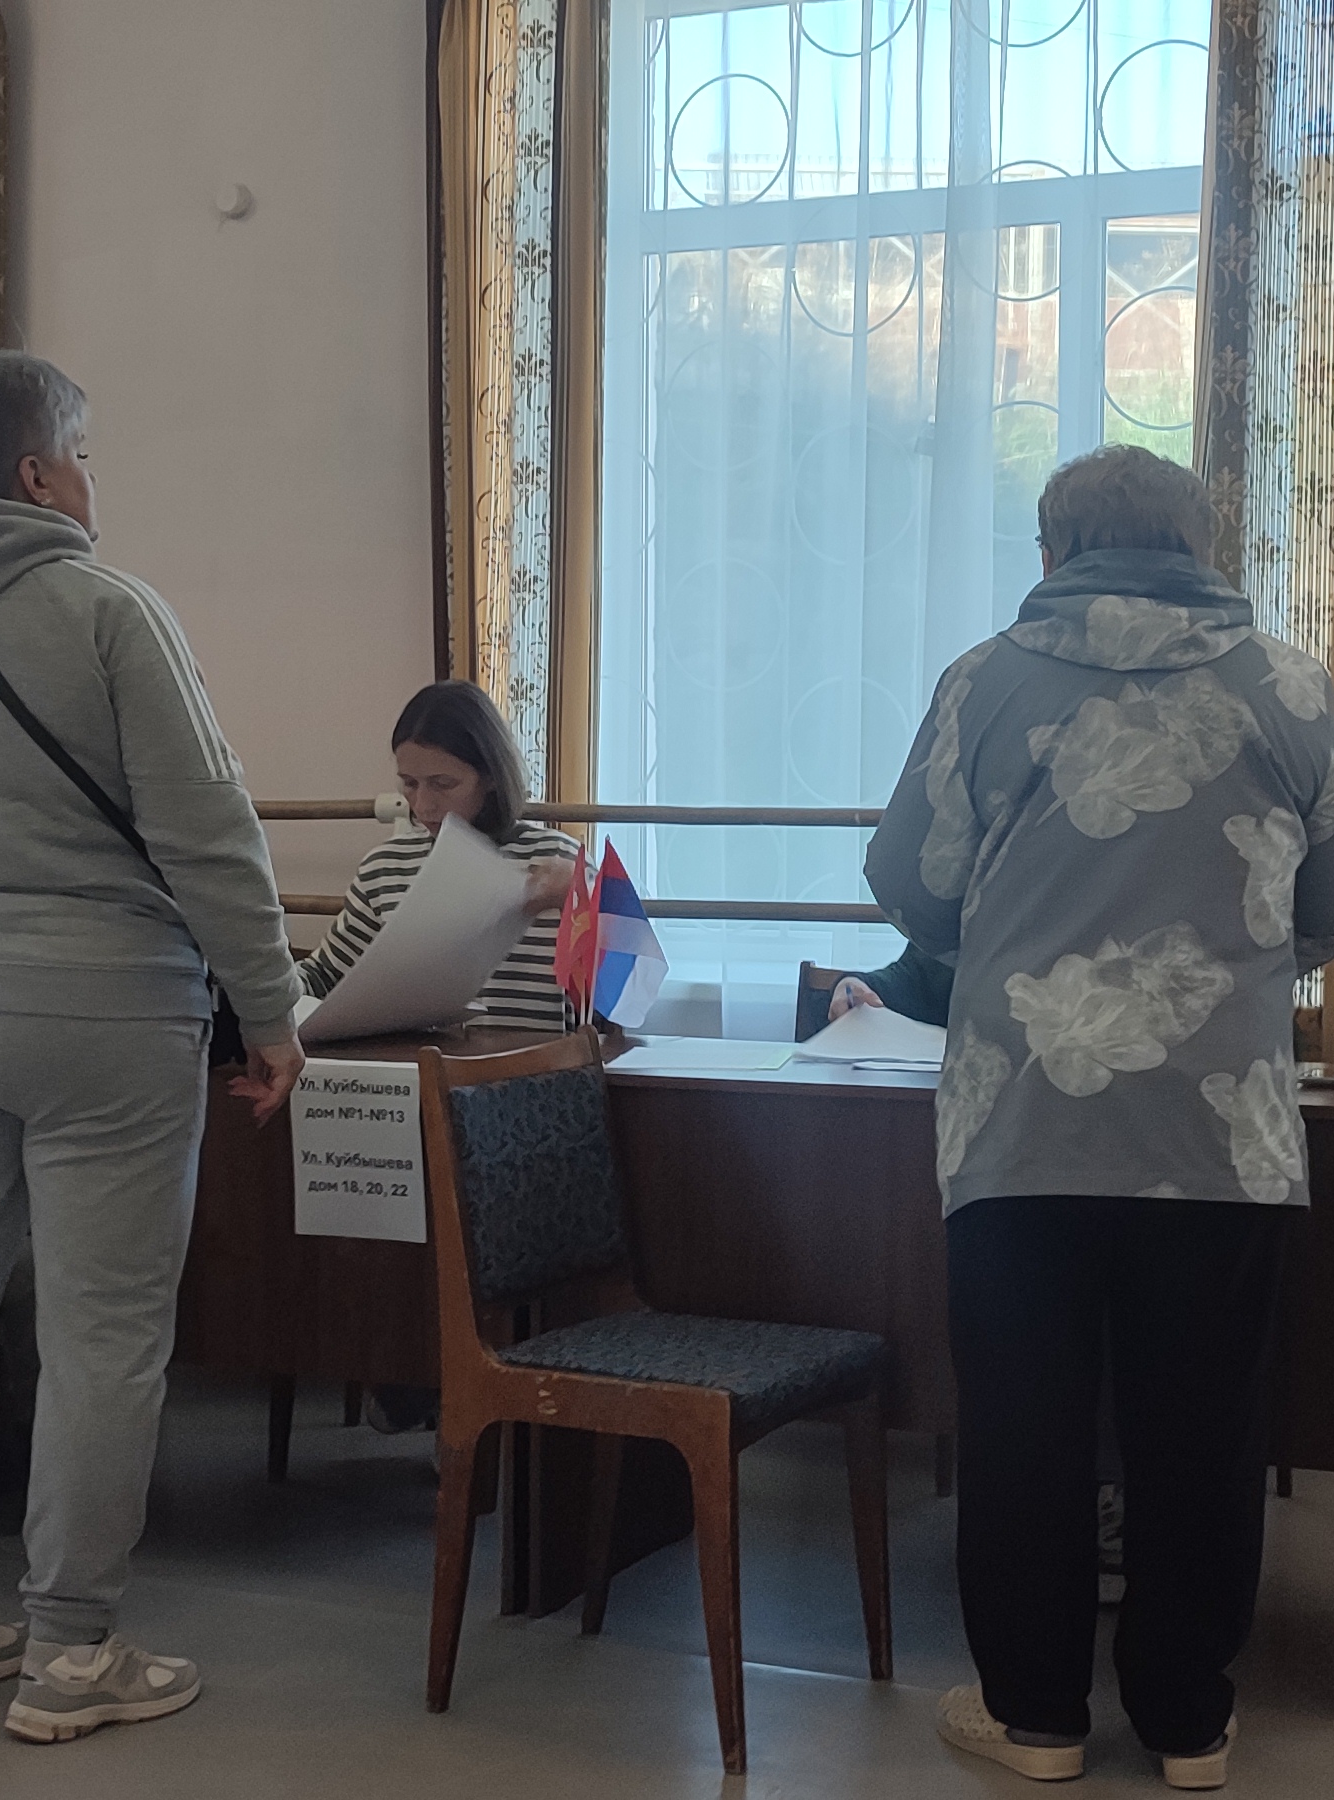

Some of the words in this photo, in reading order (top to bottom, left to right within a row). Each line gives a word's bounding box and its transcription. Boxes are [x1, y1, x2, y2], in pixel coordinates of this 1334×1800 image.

[299, 1077, 319, 1091] Ул.
[323, 1078, 411, 1096] Куйбышева
[305, 1107, 335, 1119] дом
[339, 1107, 405, 1122] №1-№13
[301, 1150, 322, 1164] Ул.
[325, 1152, 413, 1170] Куйбышева
[308, 1181, 338, 1192] дом
[342, 1180, 363, 1195] 18,
[366, 1182, 388, 1197] 20,
[391, 1184, 408, 1196] 22
